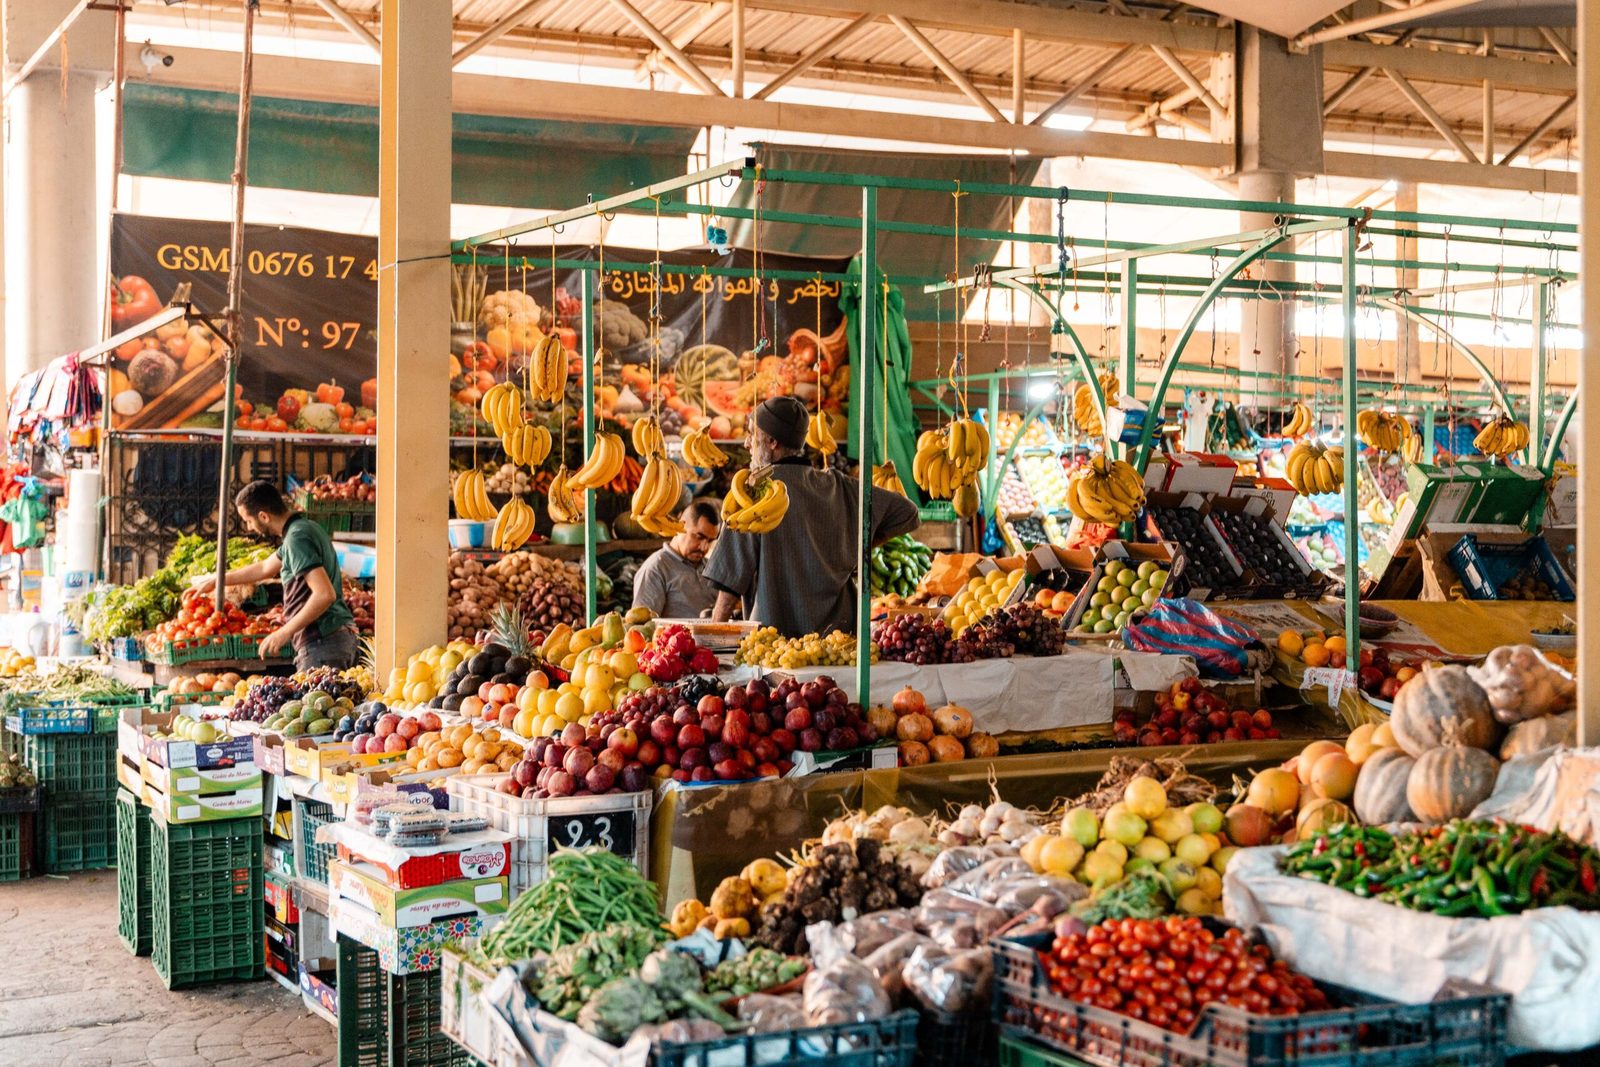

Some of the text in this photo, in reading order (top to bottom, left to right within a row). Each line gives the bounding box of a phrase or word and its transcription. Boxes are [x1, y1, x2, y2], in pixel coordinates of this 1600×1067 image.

[157, 243, 230, 273] GSM
[248, 251, 314, 277] 0676
[325, 255, 355, 279] 17
[767, 279, 780, 302] و
[787, 278, 842, 305] لخضر
[322, 322, 360, 350] 97
[567, 816, 614, 852] 23
